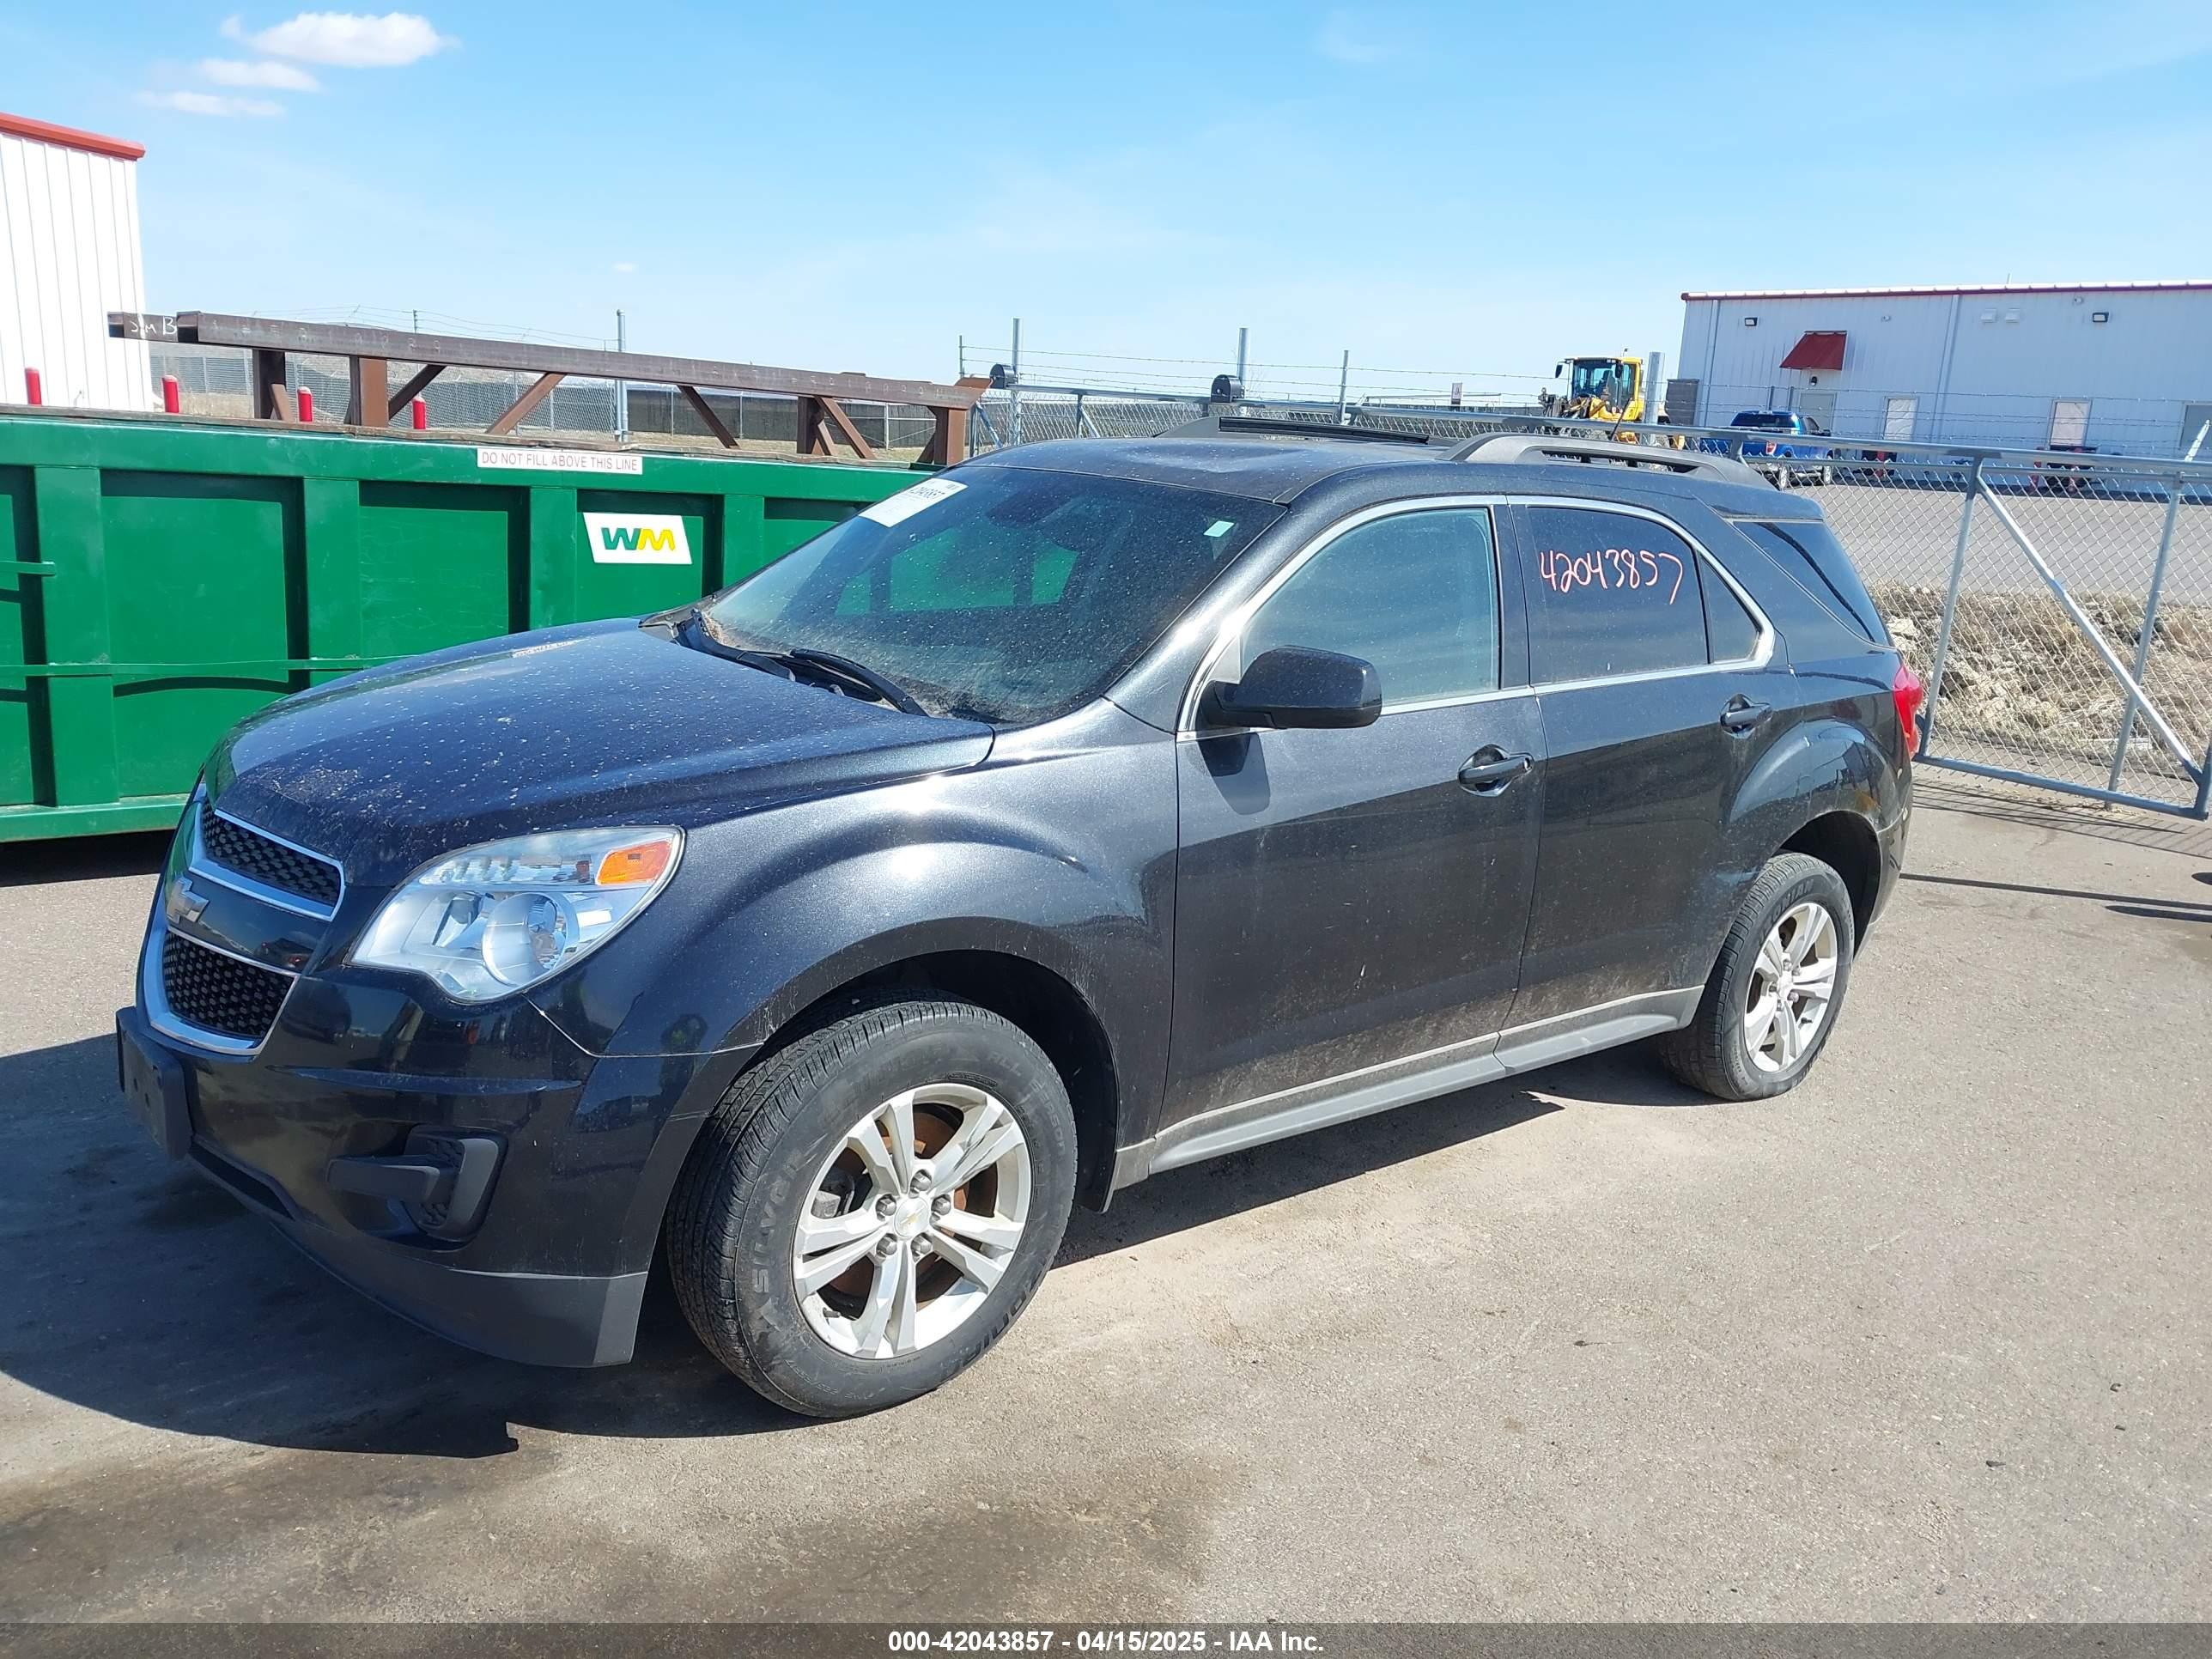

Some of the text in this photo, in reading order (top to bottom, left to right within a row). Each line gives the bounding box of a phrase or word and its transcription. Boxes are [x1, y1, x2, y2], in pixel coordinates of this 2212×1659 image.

[482, 452, 638, 471] DO NOT FILL ABOVE THIS LINE
[600, 527, 676, 551] WM
[1540, 549, 1684, 605] 42043857
